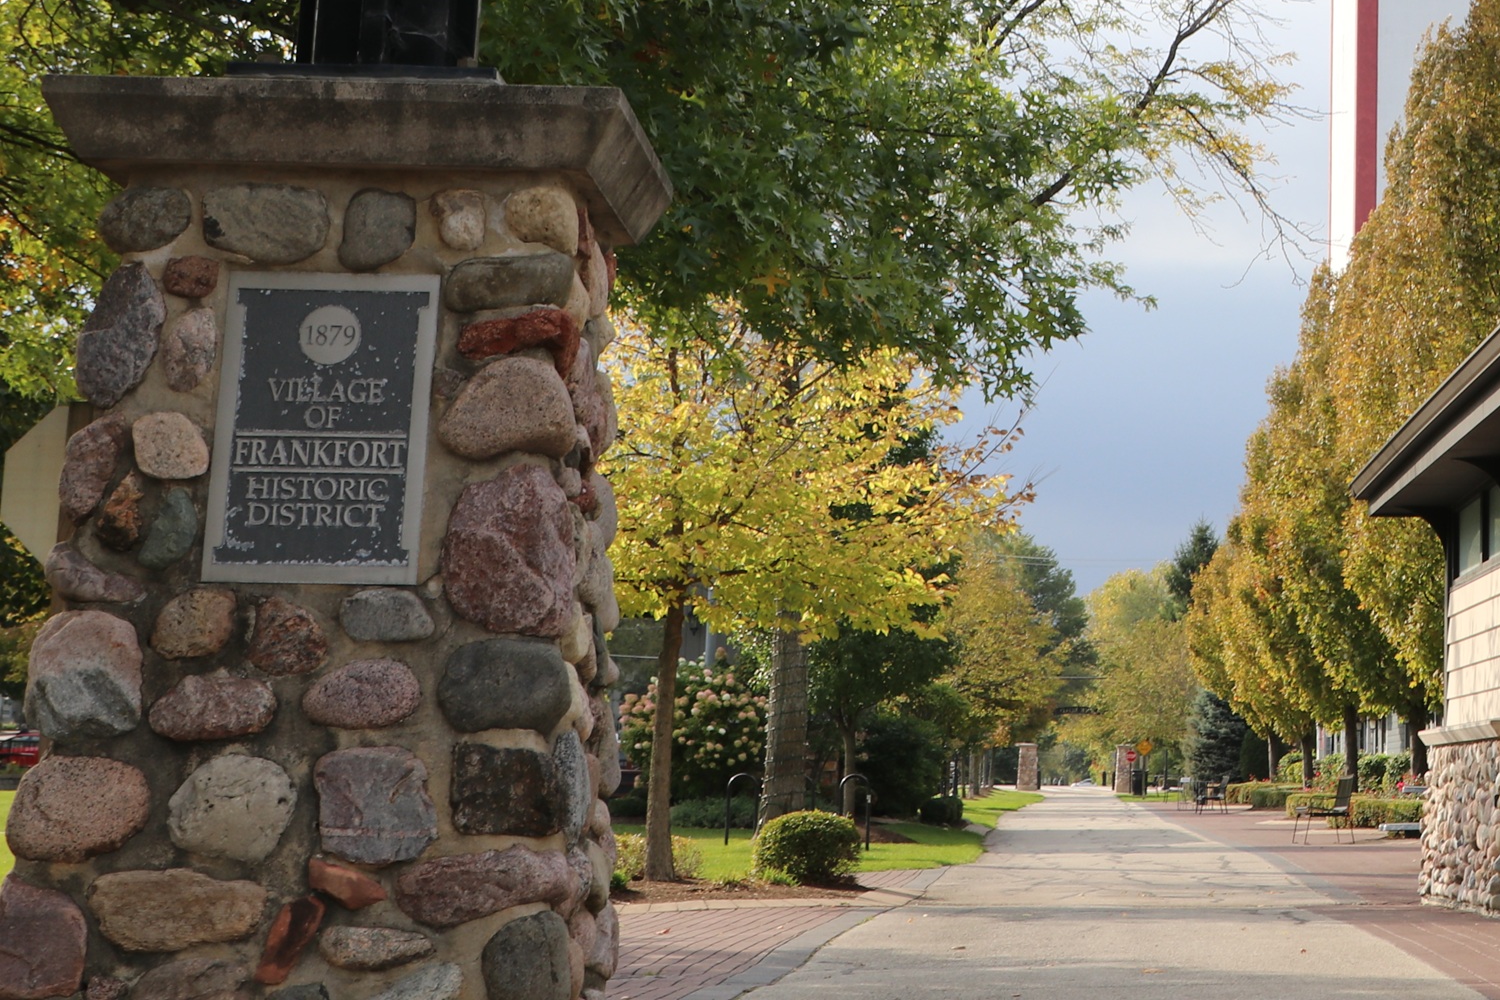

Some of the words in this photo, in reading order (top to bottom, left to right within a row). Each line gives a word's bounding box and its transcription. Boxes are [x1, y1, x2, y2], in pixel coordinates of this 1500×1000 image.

[304, 325, 356, 346] 1879
[268, 377, 386, 403] VILLAGE
[304, 406, 342, 428] OF
[233, 438, 406, 468] FRANKFORT
[246, 476, 389, 501] HISTORIC
[246, 502, 385, 527] DISTRICT
